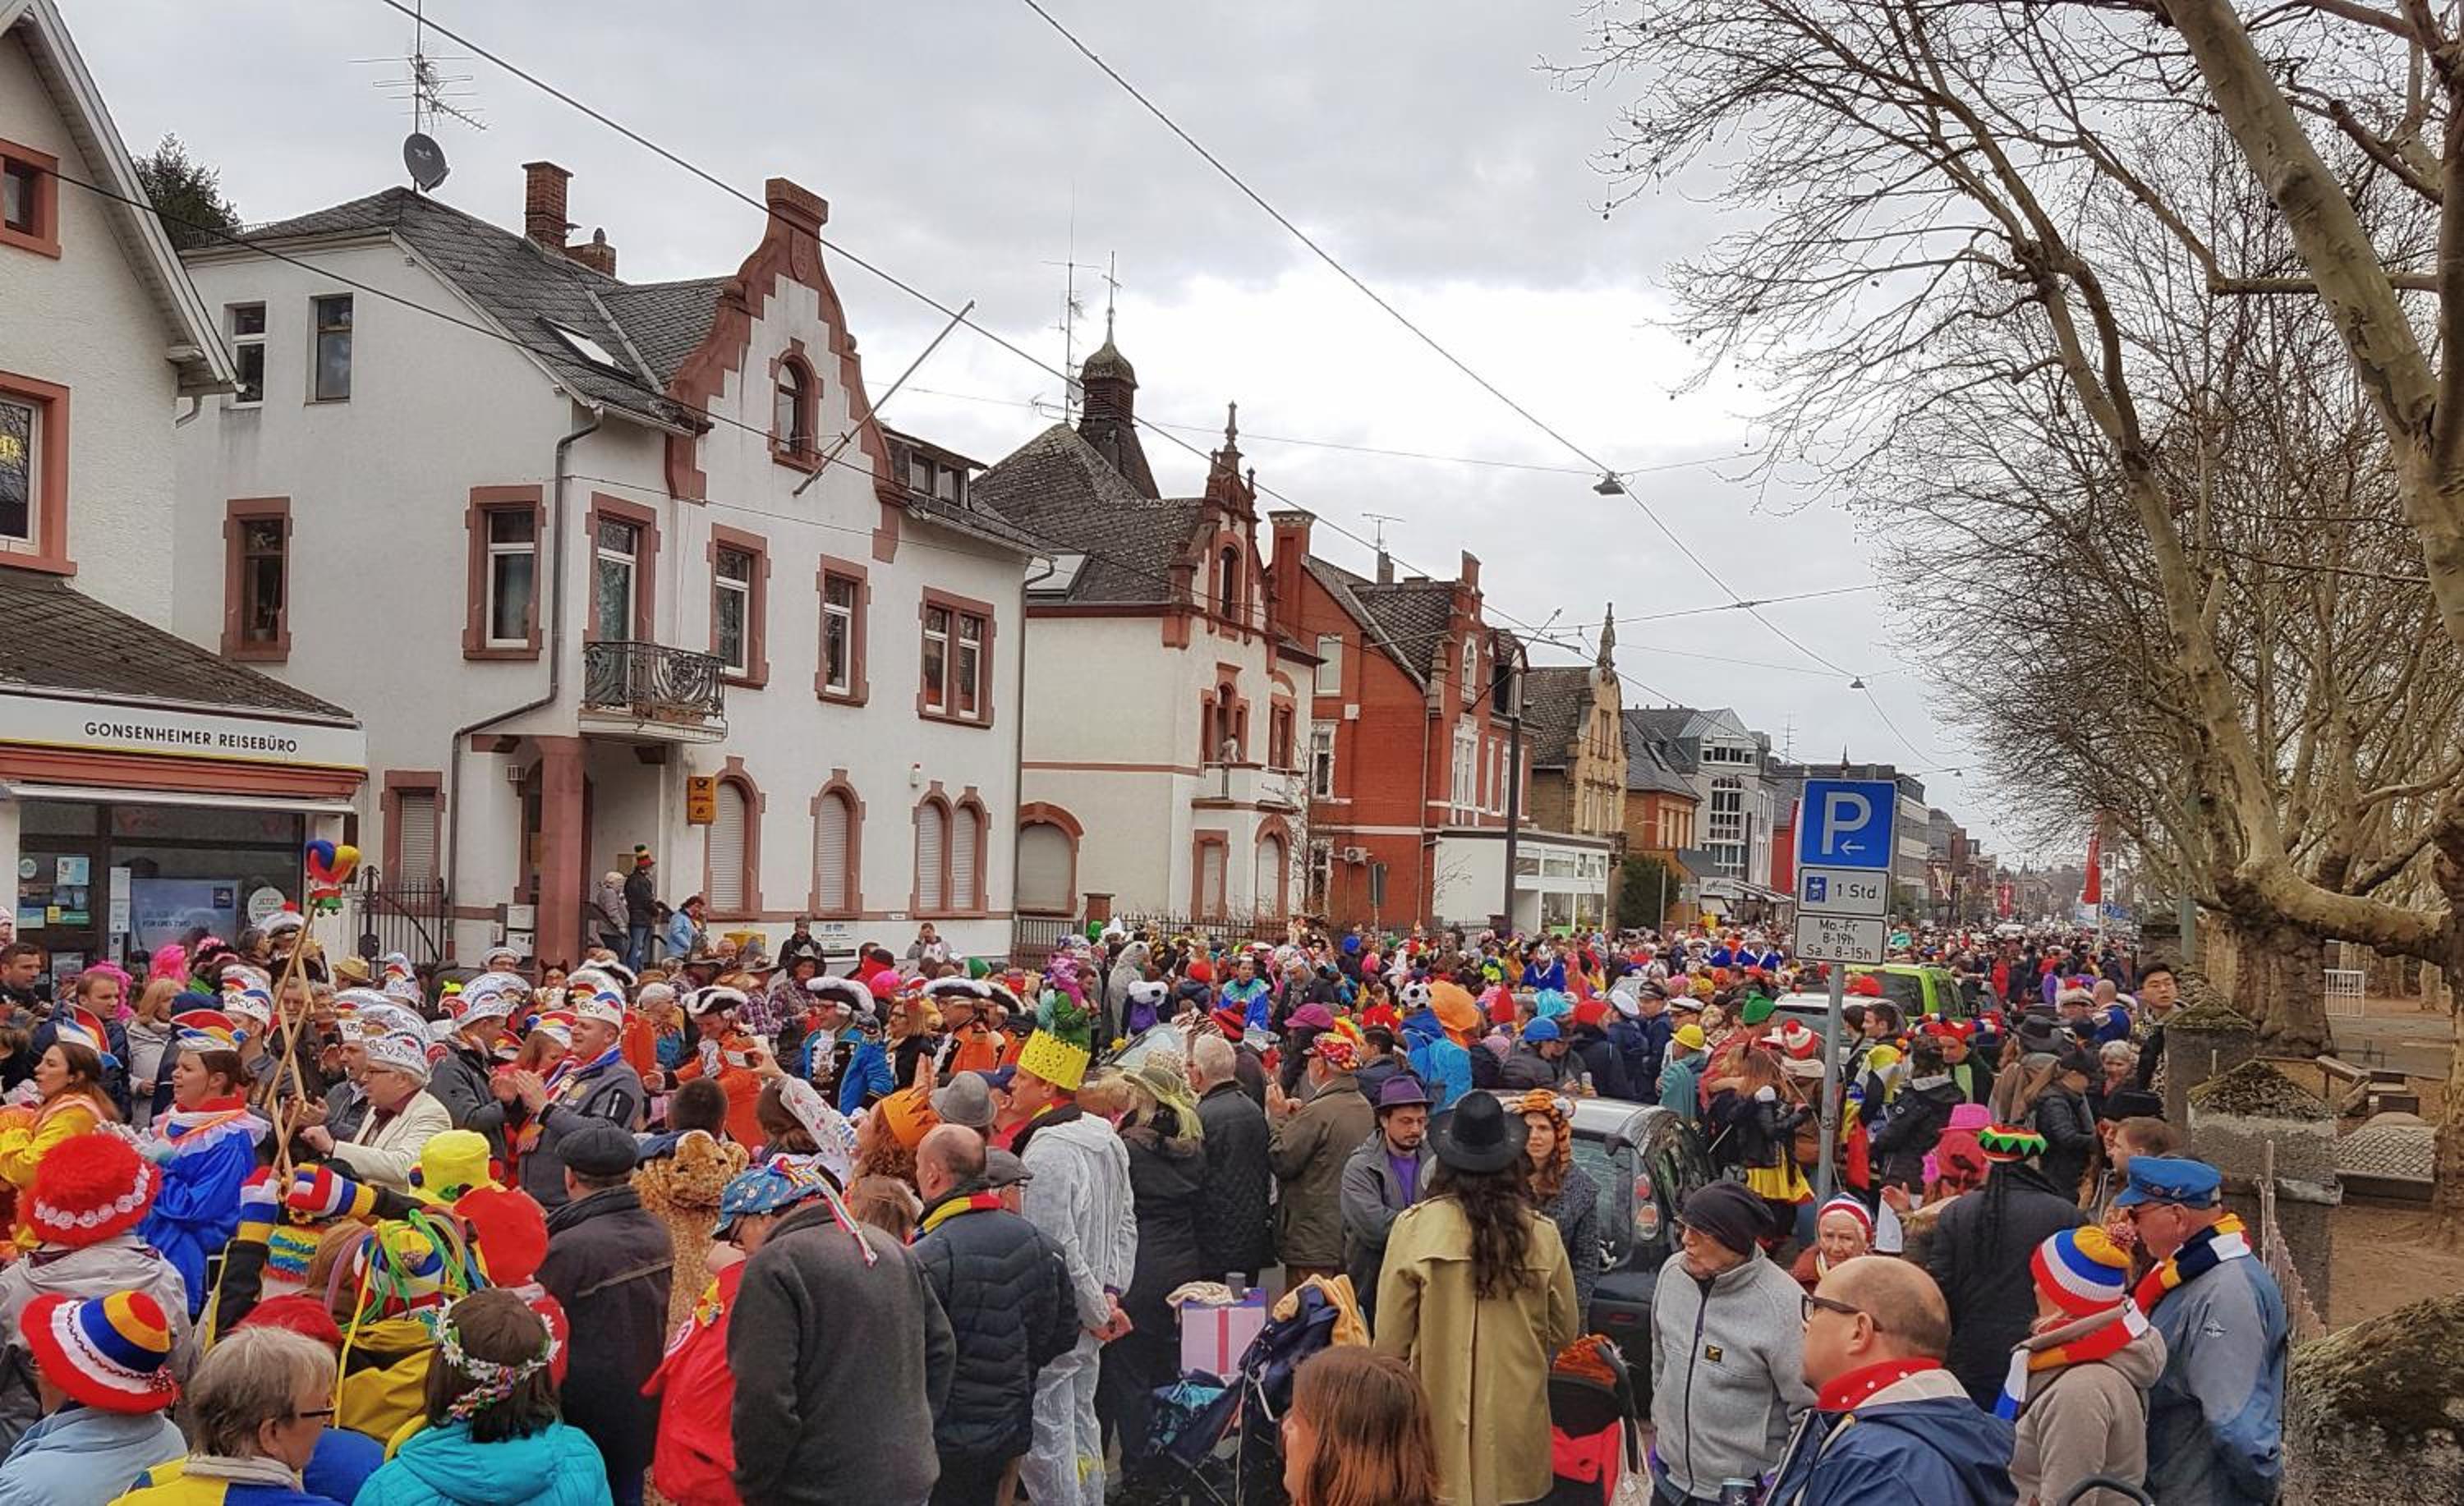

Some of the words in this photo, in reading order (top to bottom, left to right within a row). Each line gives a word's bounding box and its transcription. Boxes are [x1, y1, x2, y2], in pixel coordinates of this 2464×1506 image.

[85, 722, 211, 745] GONSENHEIMER
[219, 733, 297, 753] REISEBÜRO
[1821, 792, 1872, 855] P
[1837, 884, 1842, 897] 1
[1850, 884, 1880, 899] Std.
[1823, 934, 1855, 944] 8-19h
[1807, 944, 1826, 957] Sa.
[1834, 946, 1872, 960] 8-15h
